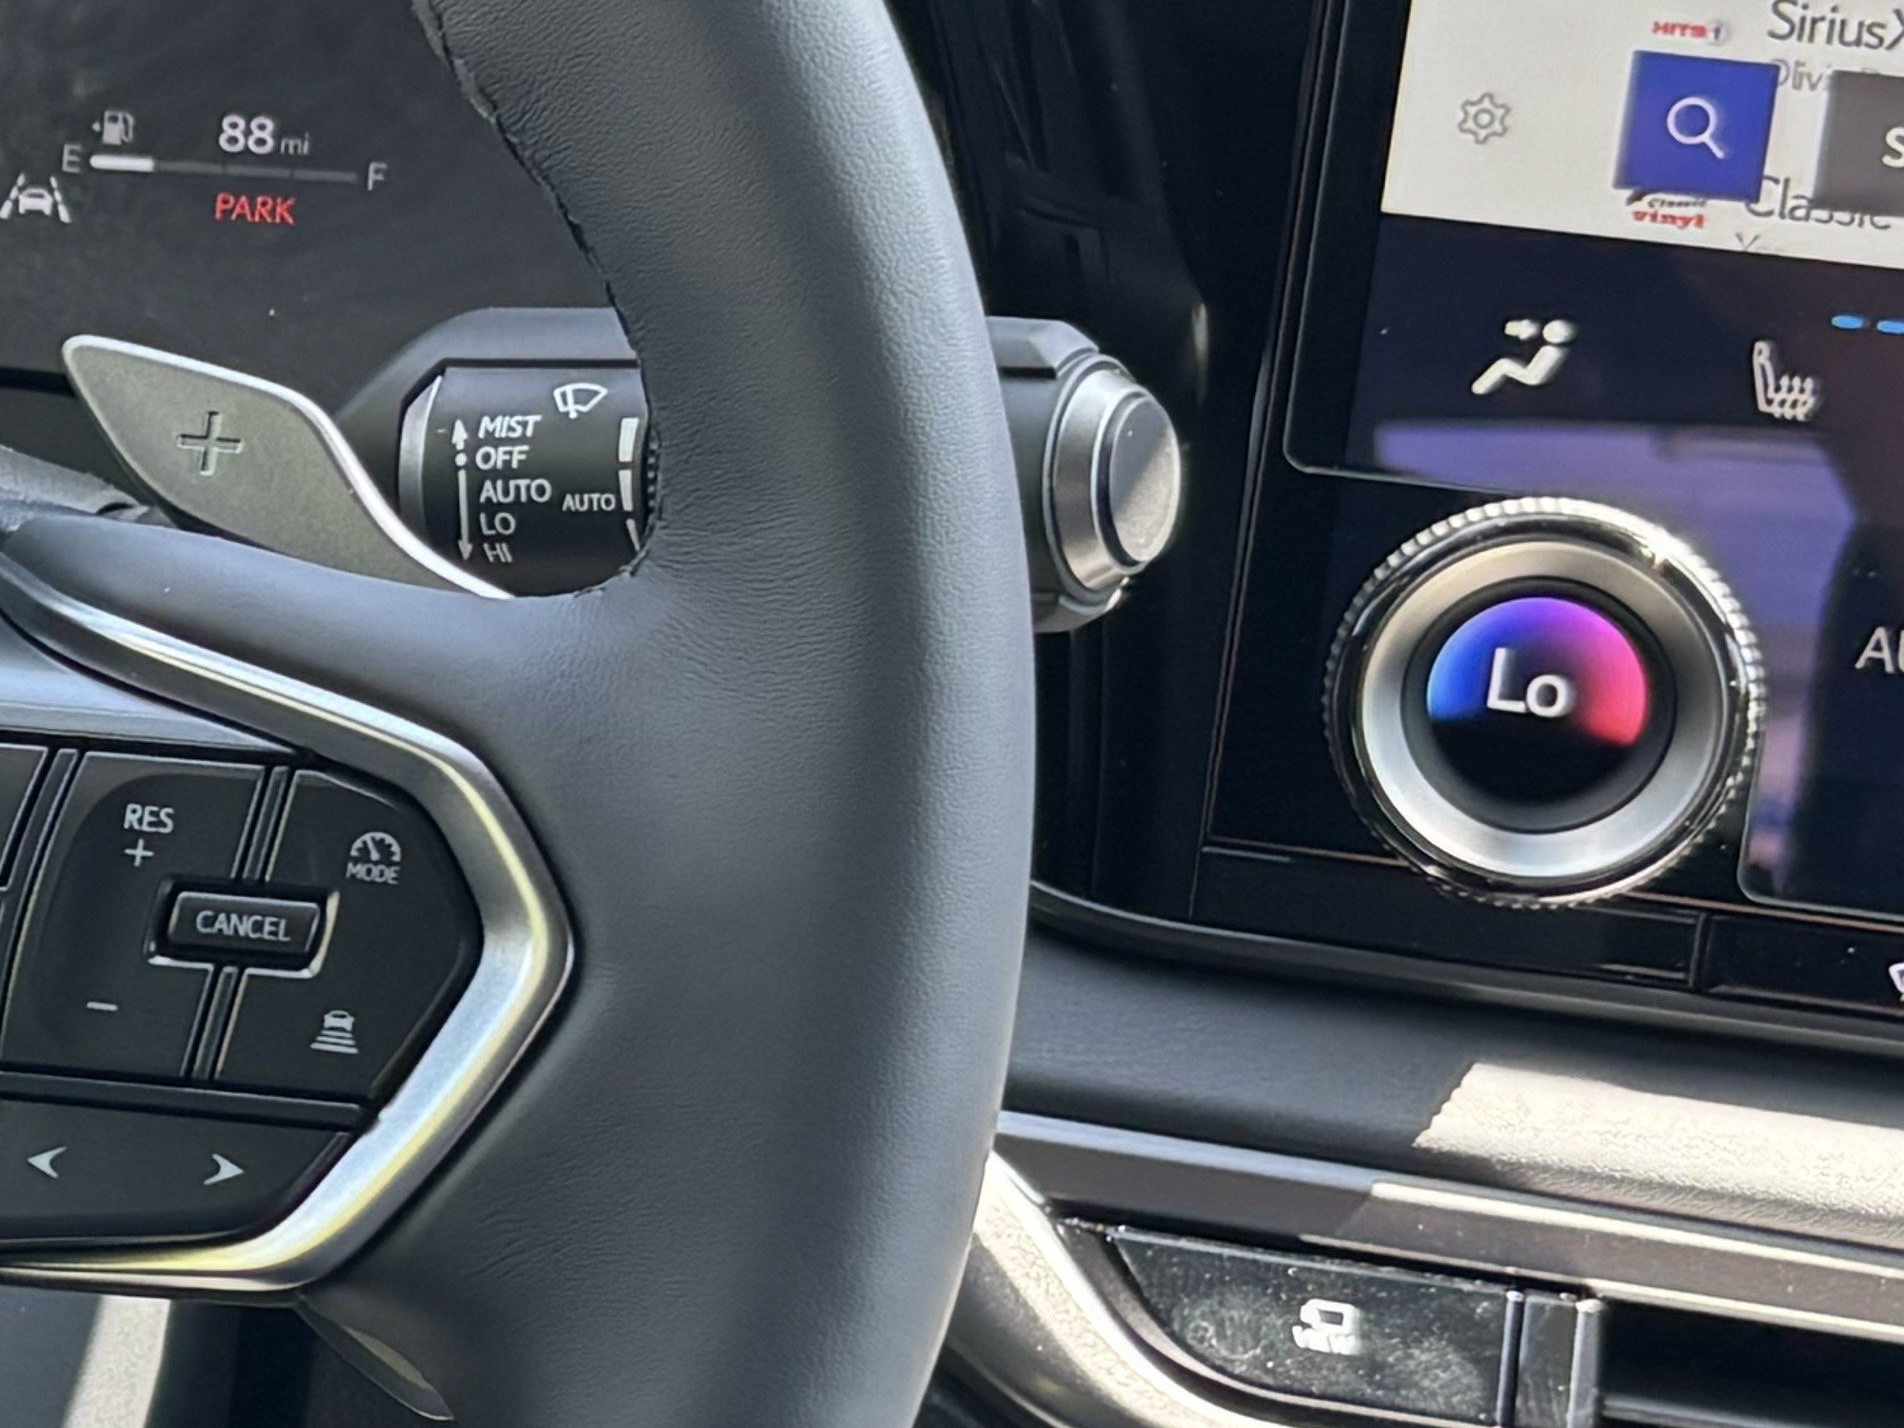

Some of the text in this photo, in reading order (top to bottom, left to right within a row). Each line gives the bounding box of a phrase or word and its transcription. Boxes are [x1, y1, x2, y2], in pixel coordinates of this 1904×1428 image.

[219, 114, 310, 155] 88 mi
[61, 145, 388, 192] E F
[214, 193, 296, 225] PARK
[478, 415, 542, 439] MIST
[475, 445, 530, 470] OFF
[479, 478, 552, 504] AUTO
[562, 493, 617, 513] AUTO
[480, 512, 516, 536] LO
[483, 542, 514, 564] HI
[1485, 647, 1570, 719] Lo
[123, 802, 176, 835] RES
[345, 860, 402, 886] MODE
[195, 908, 292, 944] CANCEL
